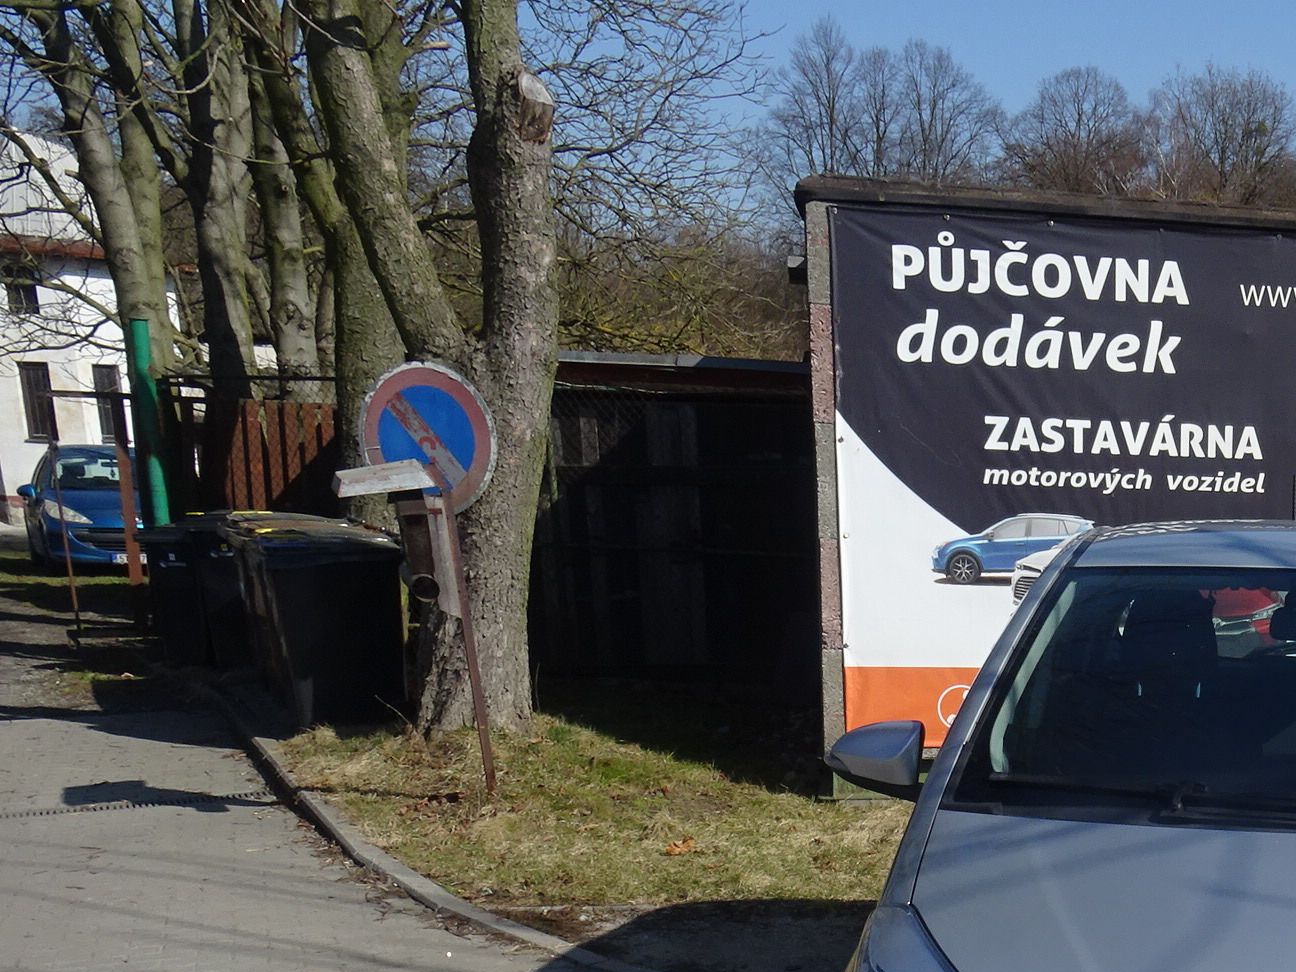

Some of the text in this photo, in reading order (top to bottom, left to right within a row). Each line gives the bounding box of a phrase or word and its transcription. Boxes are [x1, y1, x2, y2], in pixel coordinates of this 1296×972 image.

[891, 231, 1190, 305] PŮJČOVNA
[896, 308, 1182, 374] dodávek
[983, 414, 1264, 460] ZASTAVÁRNA
[982, 467, 1266, 495] motorových vozidel
